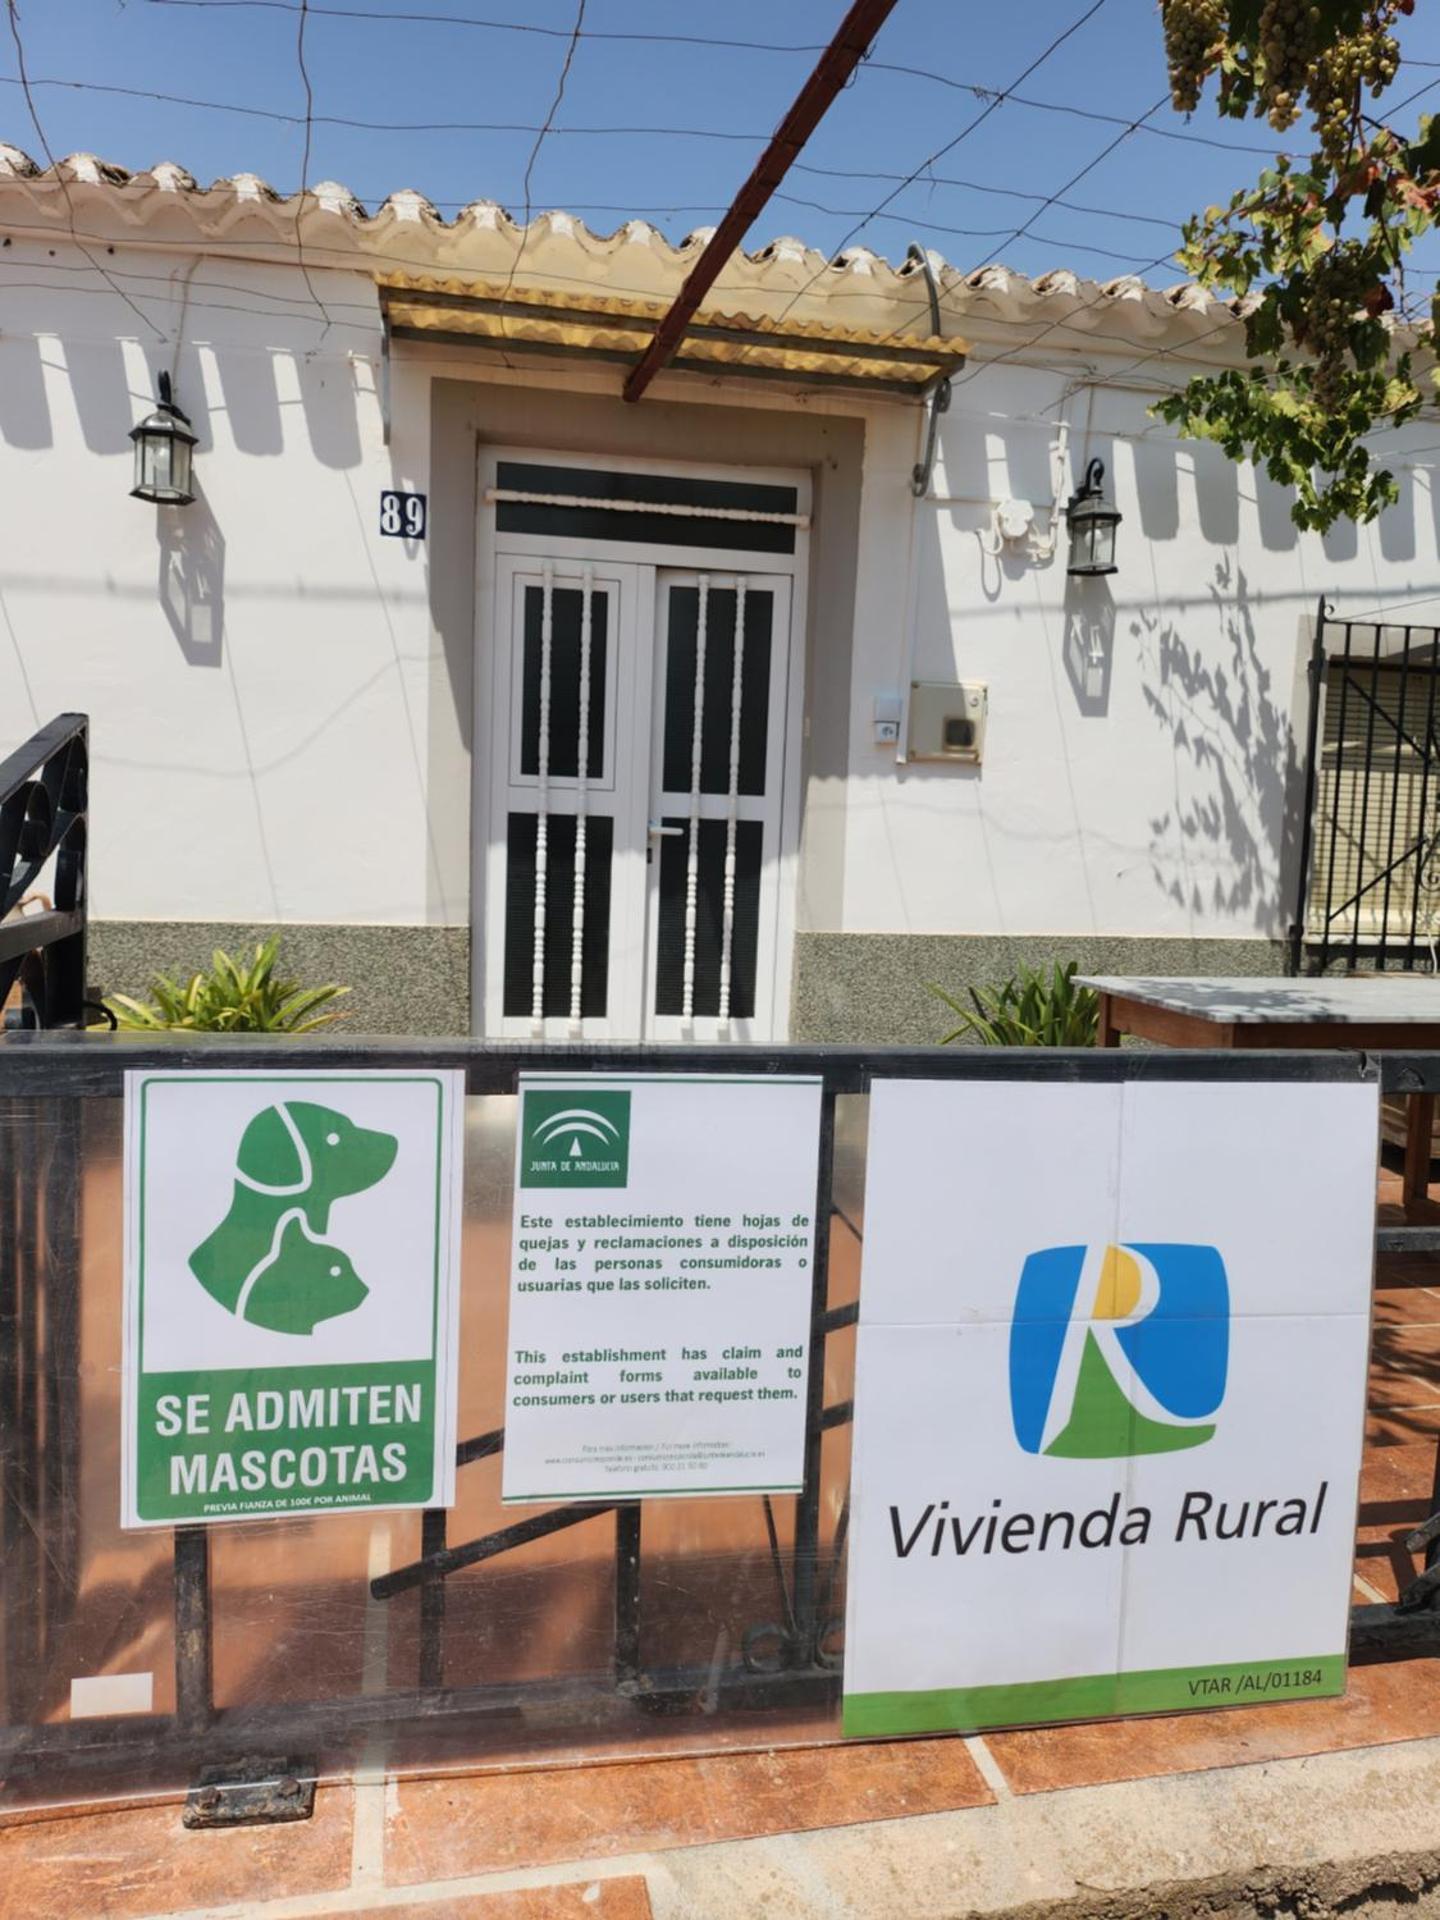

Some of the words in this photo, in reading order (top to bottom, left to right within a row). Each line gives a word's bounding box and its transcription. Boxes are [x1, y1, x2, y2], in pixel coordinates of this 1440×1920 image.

[381, 494, 424, 536] 89
[530, 1160, 557, 1172] JUNTA
[560, 1161, 571, 1172] DE
[521, 1215, 553, 1229] Este
[565, 1215, 684, 1228] establecimiento
[694, 1215, 731, 1227] tiene
[743, 1215, 780, 1231] hojas
[792, 1215, 809, 1227] de
[519, 1237, 569, 1252] quejas
[578, 1238, 586, 1252] y
[594, 1236, 703, 1250] reclamaciones
[711, 1238, 719, 1249] a
[728, 1235, 808, 1252] disposición
[519, 1258, 536, 1271] de
[555, 1258, 576, 1270] las
[595, 1259, 663, 1274] personas
[680, 1256, 782, 1269] consumidoras
[799, 1258, 807, 1268] o
[518, 1279, 582, 1292] usuarias
[587, 1280, 614, 1295] que
[619, 1278, 640, 1291] las
[644, 1277, 711, 1291] soliciten.
[515, 1350, 546, 1363] This
[562, 1349, 666, 1362] establishment
[681, 1348, 707, 1360] has
[722, 1347, 762, 1359] claim
[776, 1346, 803, 1358] and
[514, 1372, 588, 1387] complaint
[620, 1370, 663, 1382] forms
[693, 1368, 758, 1381] available
[788, 1368, 801, 1379] to
[513, 1393, 595, 1406] consumers
[600, 1394, 616, 1404] or
[620, 1392, 661, 1403] users
[665, 1391, 694, 1402] that
[699, 1389, 753, 1403] request
[758, 1387, 797, 1399] them.
[155, 1393, 210, 1437] SE
[224, 1383, 422, 1433] ADMITEN
[170, 1442, 407, 1496] MASCOTAS
[204, 1503, 237, 1513] PREVIA
[240, 1500, 274, 1510] FIANZA
[276, 1499, 287, 1508] DE
[314, 1496, 333, 1504] POR
[335, 1493, 371, 1503] ANIMAL
[889, 1492, 1151, 1558] Vivienda
[1175, 1482, 1328, 1541] Rural
[1188, 1677, 1231, 1696] VTAR
[1235, 1669, 1322, 1694] /AL/01184
